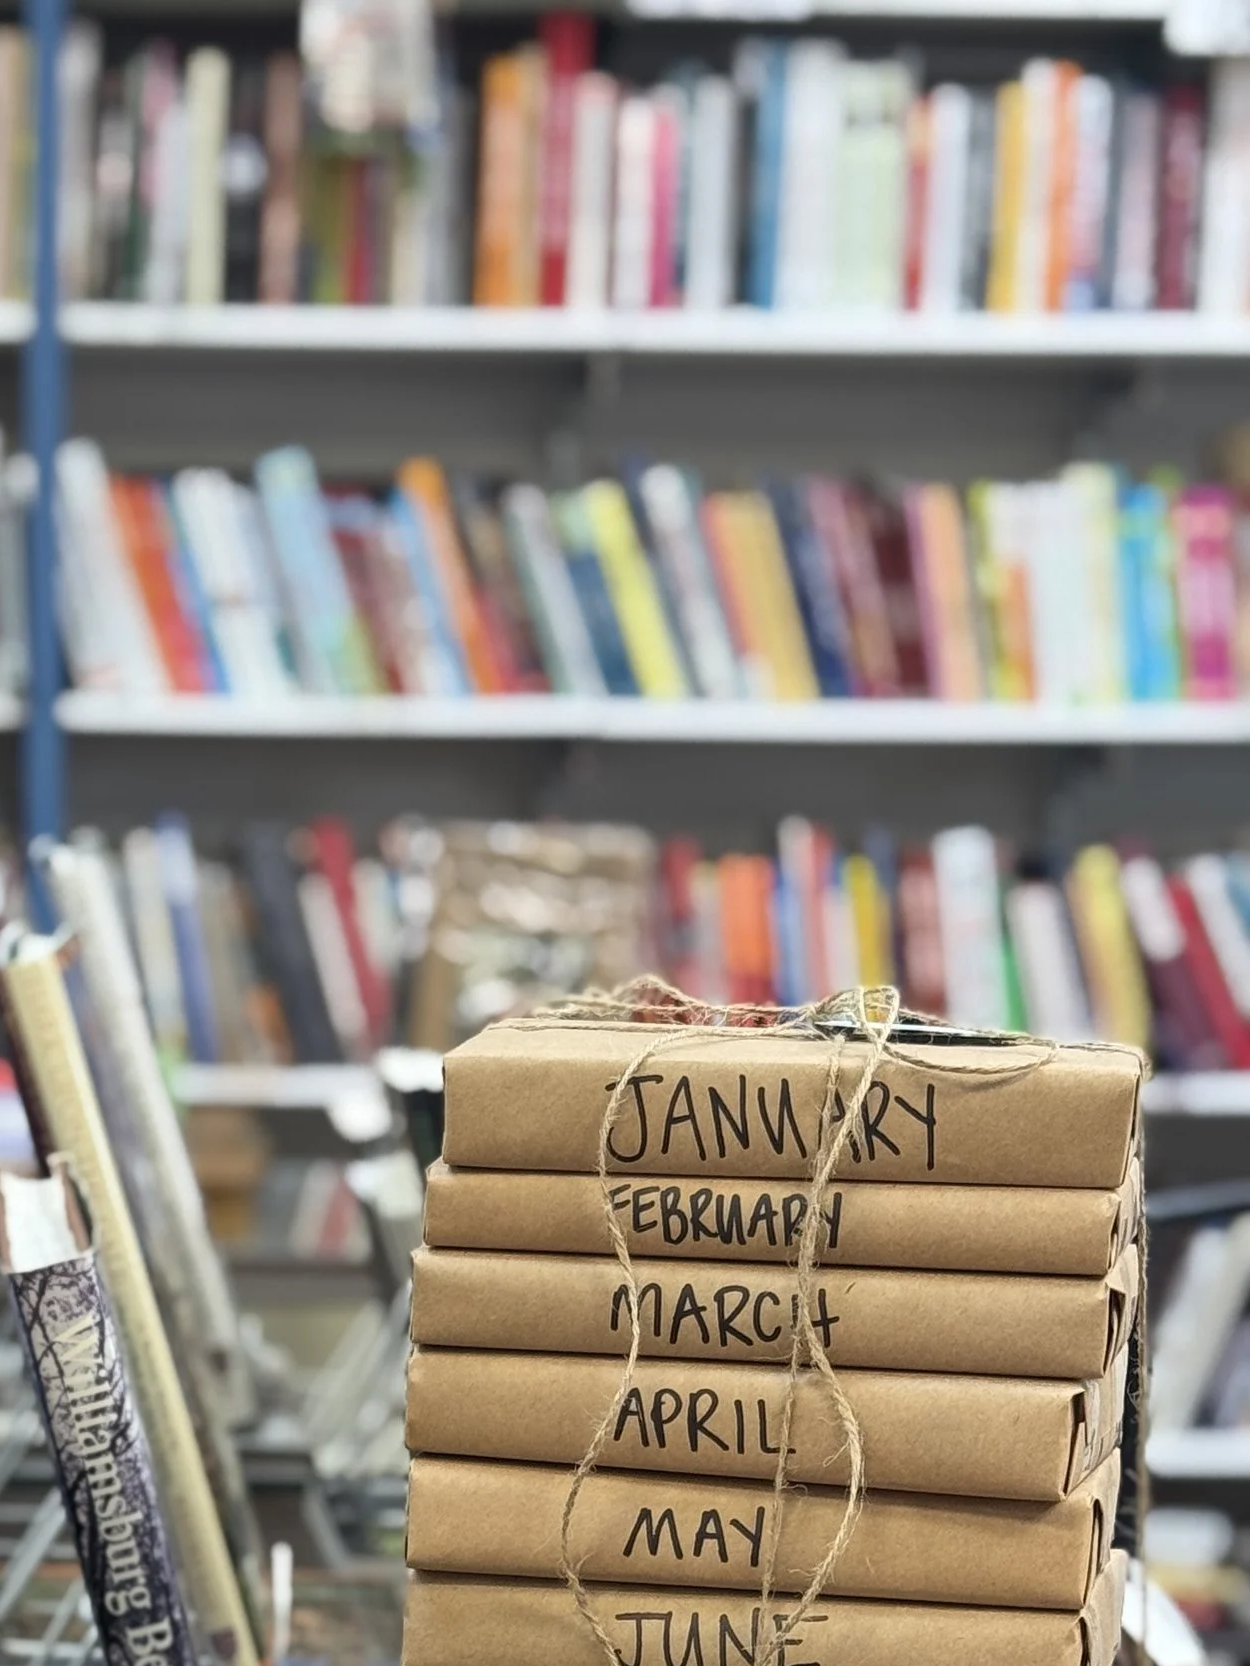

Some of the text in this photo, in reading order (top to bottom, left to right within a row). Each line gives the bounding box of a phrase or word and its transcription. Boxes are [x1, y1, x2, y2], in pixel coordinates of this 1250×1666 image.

[604, 1074, 937, 1171] JANUARY
[607, 1183, 843, 1249] FEBRUARY
[609, 1283, 840, 1348] MARCH
[613, 1387, 796, 1454] APRIL
[54, 1312, 152, 1617] Williamsburg
[622, 1506, 766, 1567] MAY
